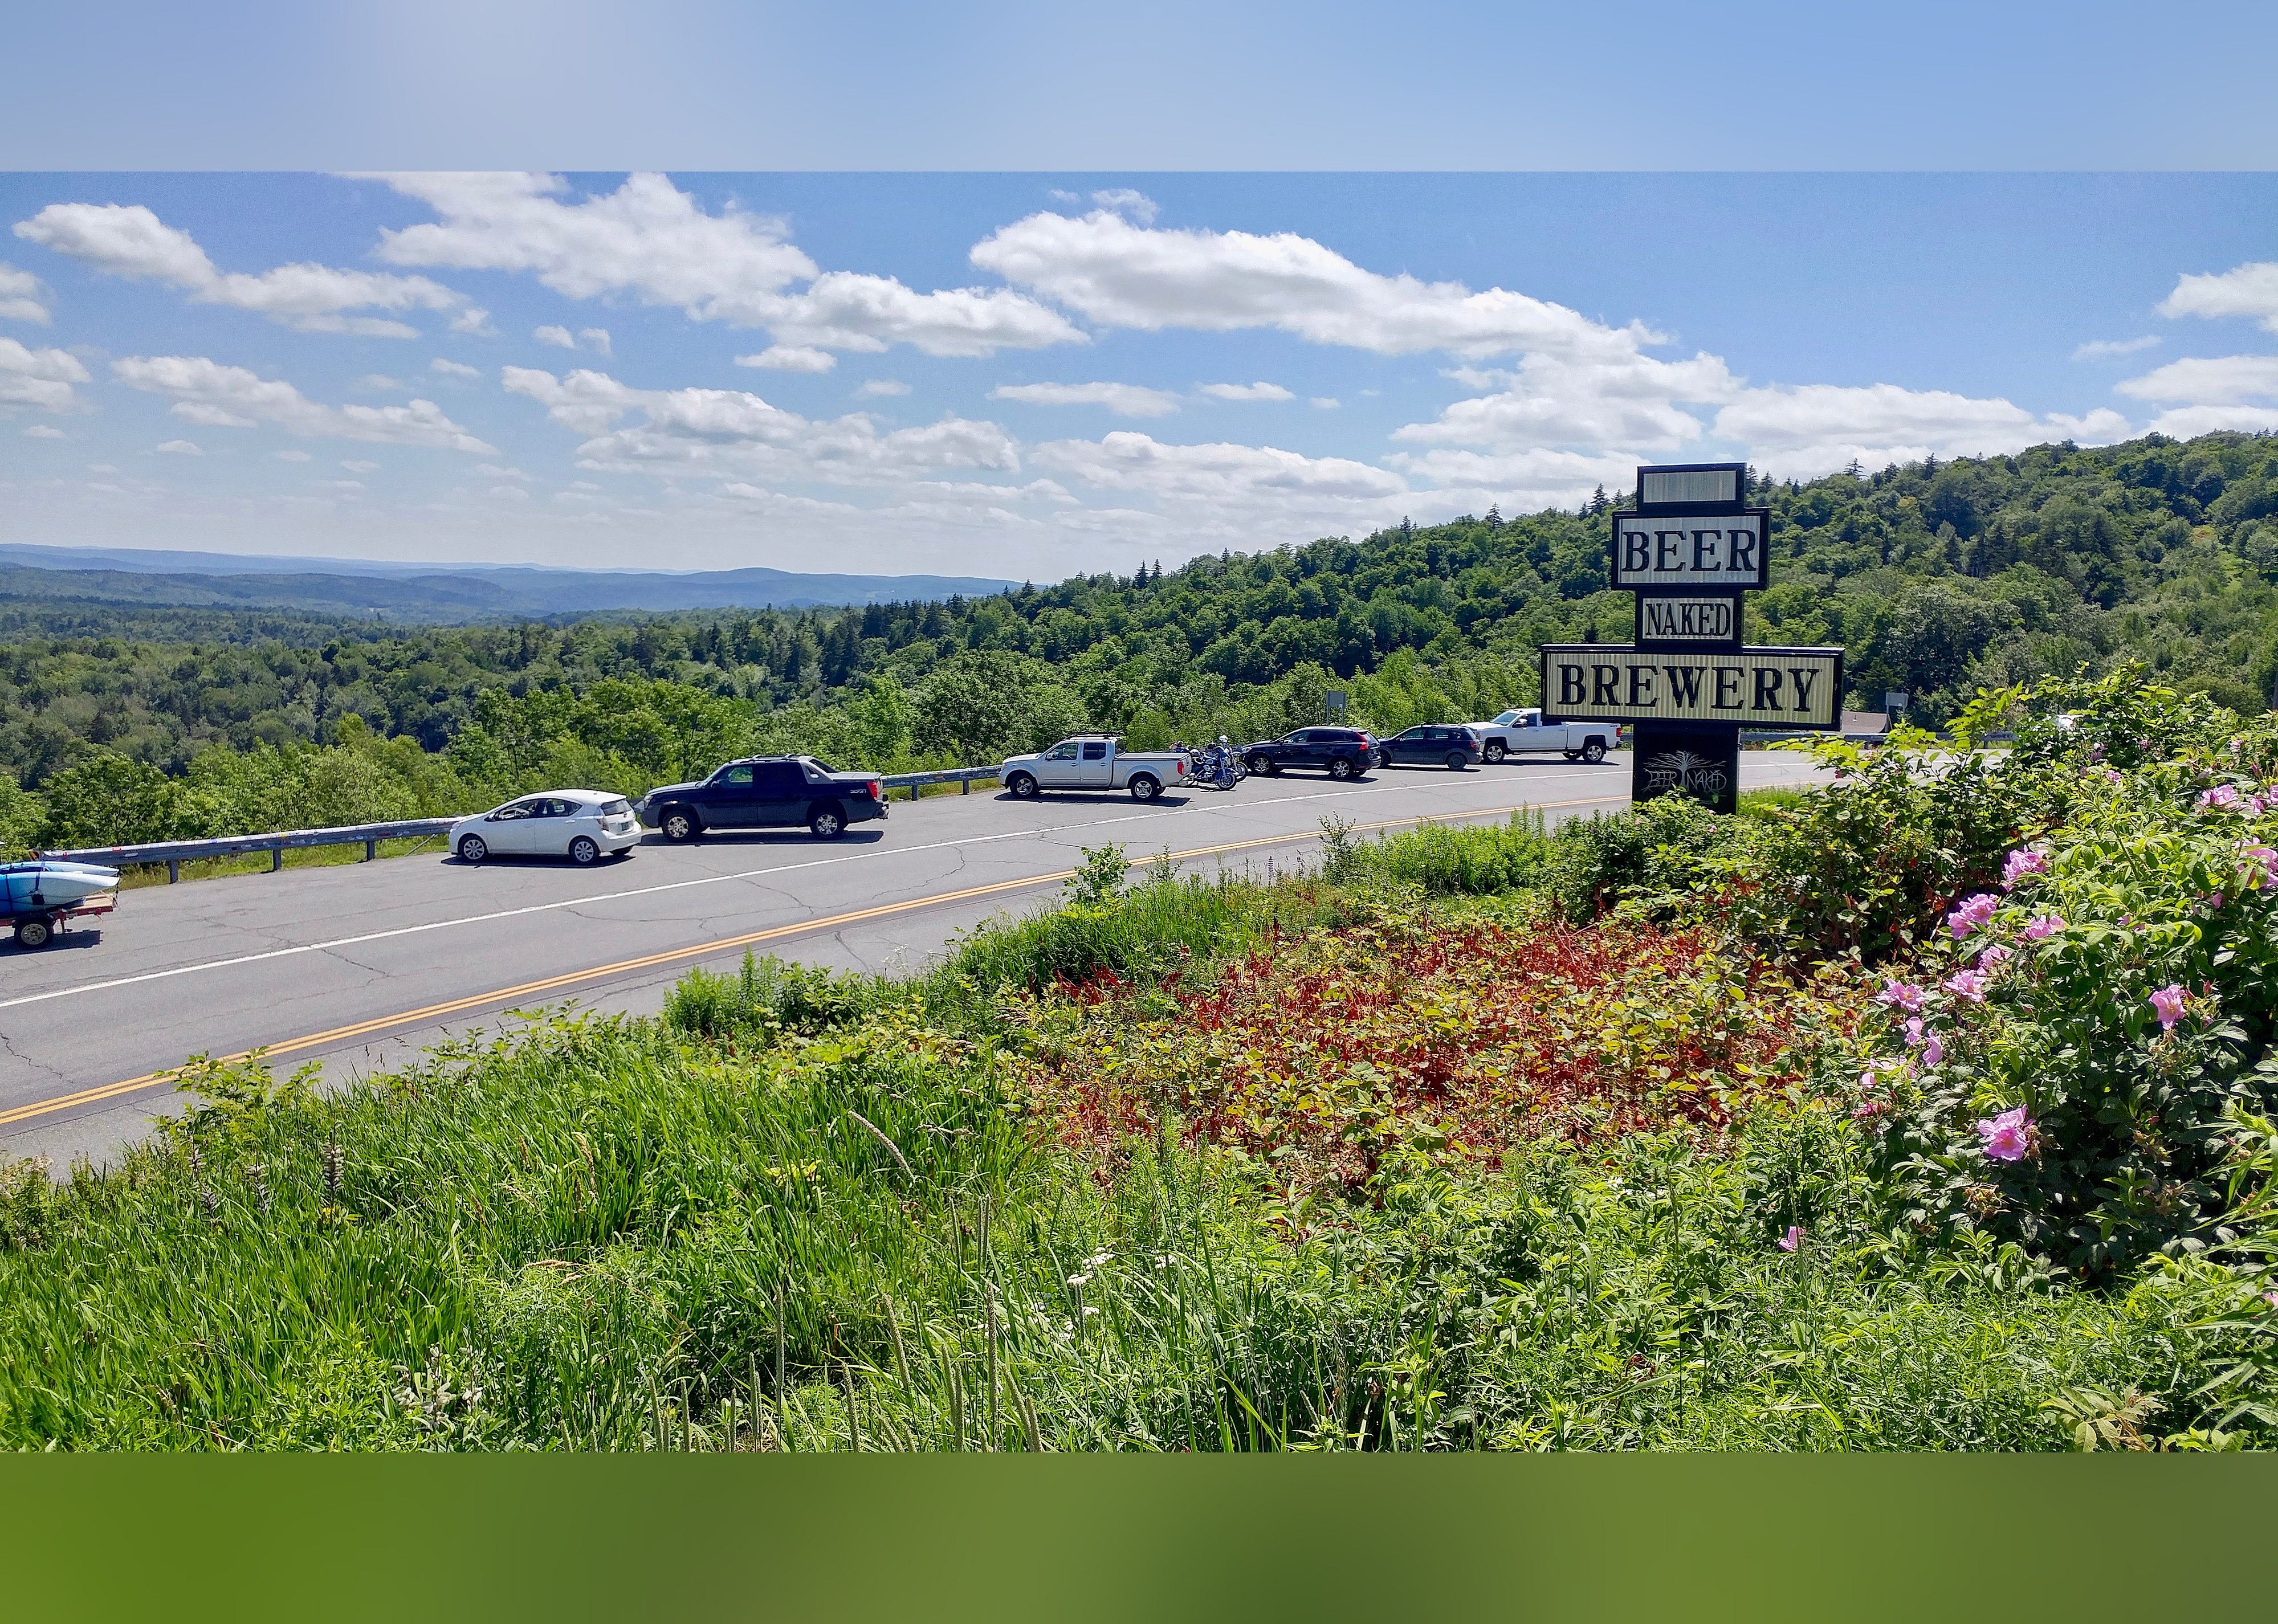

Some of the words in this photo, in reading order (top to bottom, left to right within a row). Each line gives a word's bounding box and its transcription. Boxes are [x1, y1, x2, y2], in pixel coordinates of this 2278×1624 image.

[1622, 529, 1757, 572] BEER
[1645, 602, 1731, 636] NAKED
[1556, 663, 1820, 713] BREWERY
[1686, 768, 1727, 794] NAKED
